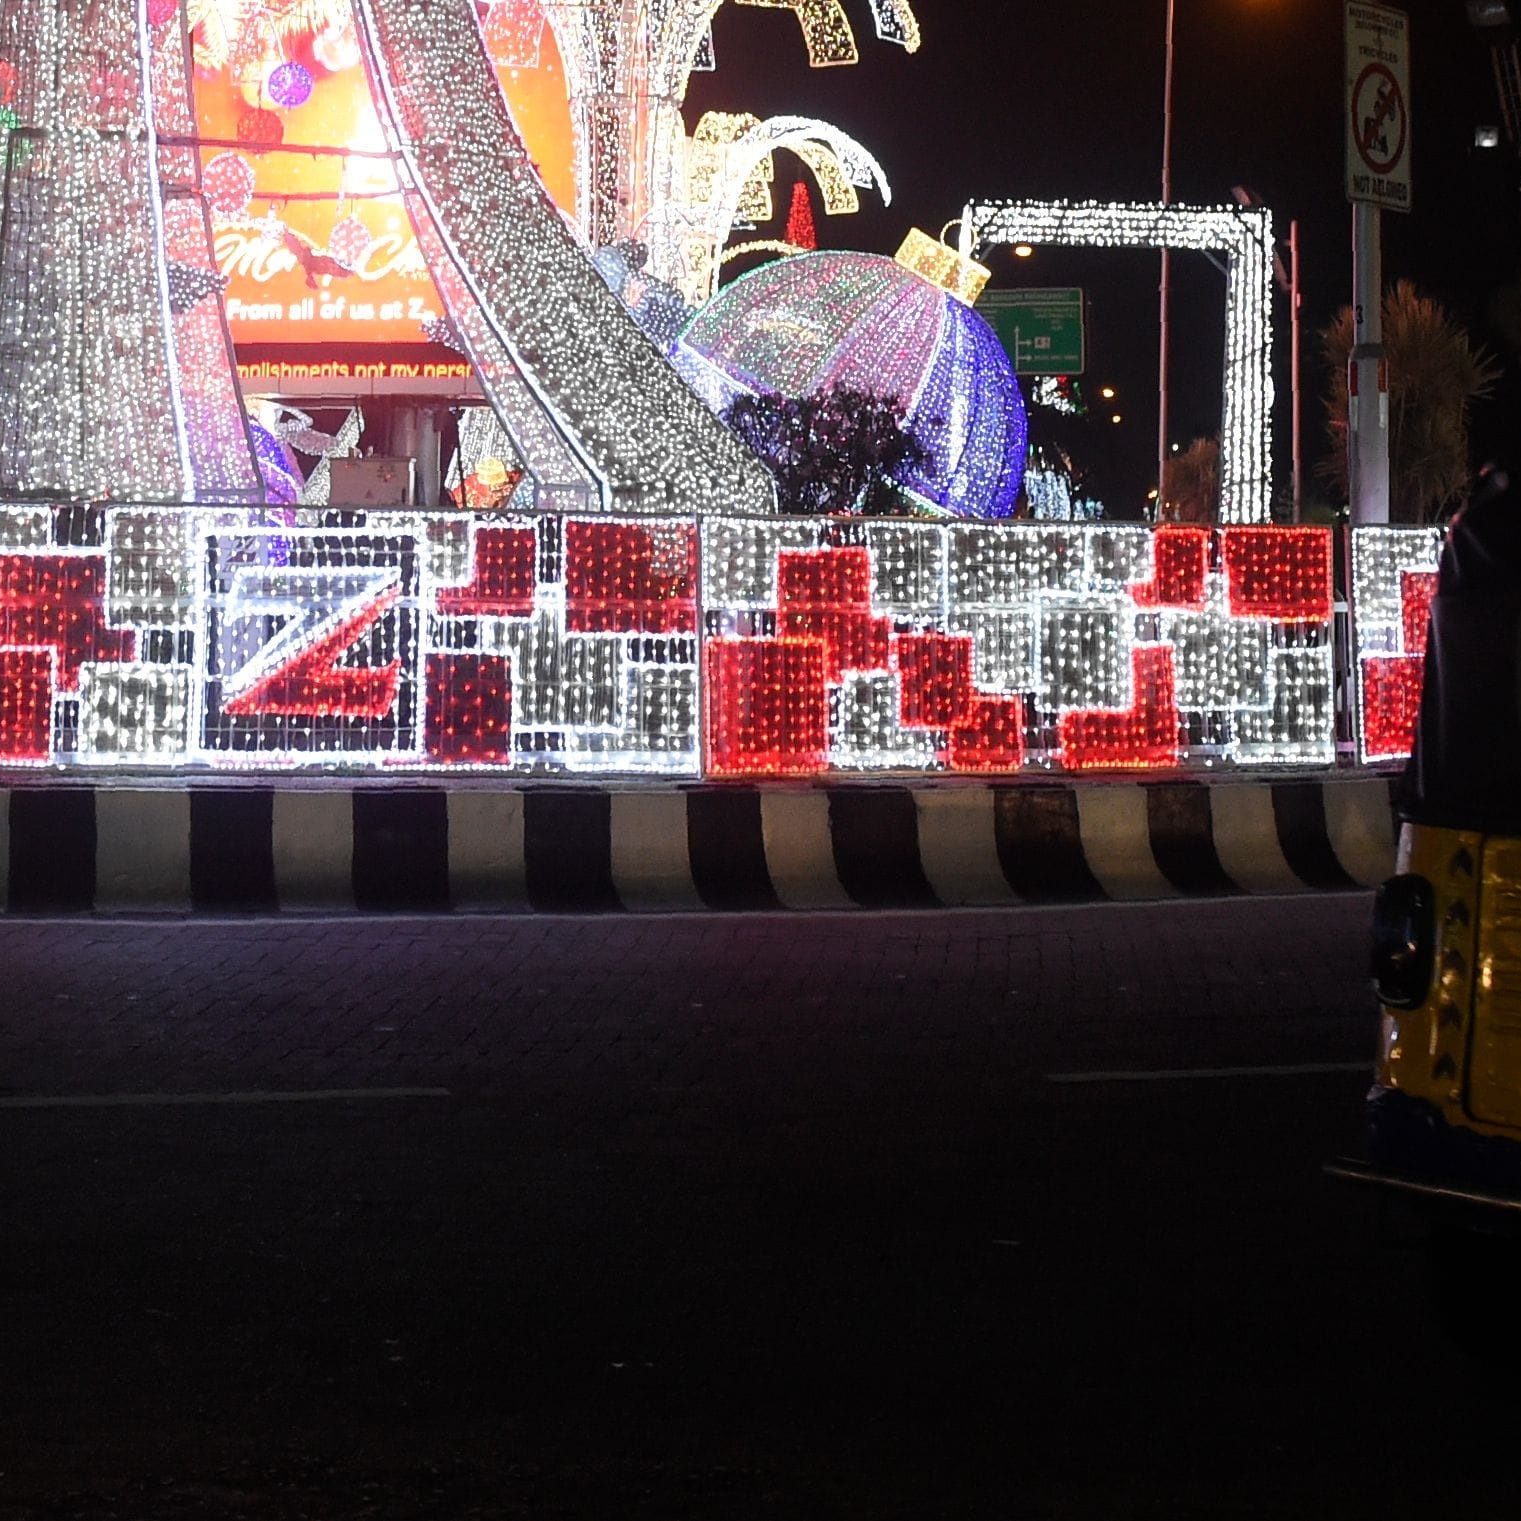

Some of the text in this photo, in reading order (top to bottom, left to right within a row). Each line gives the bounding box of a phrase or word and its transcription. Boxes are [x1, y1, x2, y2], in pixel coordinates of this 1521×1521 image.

[225, 298, 283, 320] From
[288, 297, 315, 320] all
[319, 296, 346, 320] of
[349, 303, 375, 320] us
[379, 300, 404, 320] at
